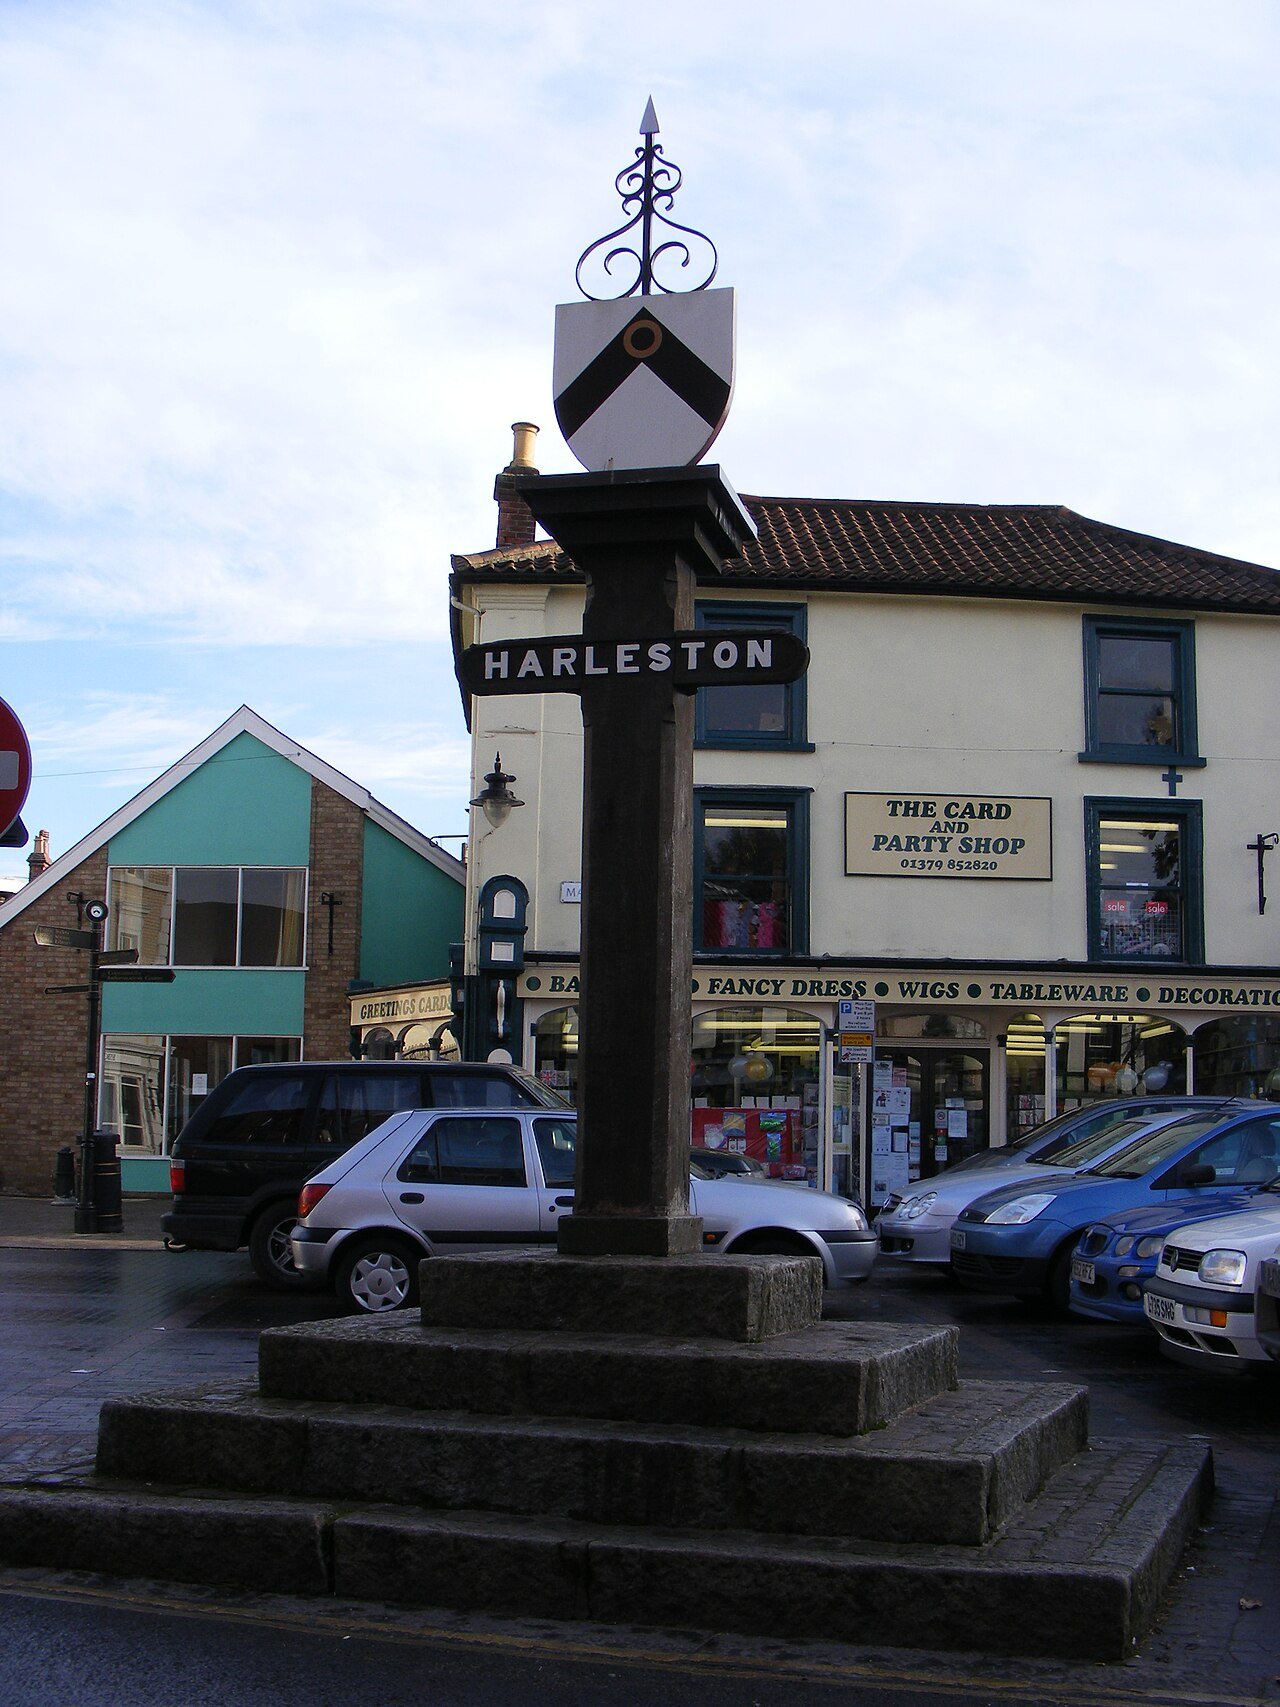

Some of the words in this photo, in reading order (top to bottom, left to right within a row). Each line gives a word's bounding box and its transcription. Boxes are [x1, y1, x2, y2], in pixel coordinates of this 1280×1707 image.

[484, 639, 772, 680] HARLESTON
[886, 800, 937, 817] THE
[943, 801, 1012, 820] CARD
[929, 821, 969, 834] AND
[871, 834, 953, 853] PARTY
[958, 836, 1026, 855] SHOP
[900, 858, 943, 871] 01379
[947, 859, 998, 871] 852820
[1107, 903, 1125, 912] sale
[1147, 904, 1165, 914] sale
[707, 978, 785, 996] FANCY
[791, 980, 867, 997] DRESS
[898, 981, 960, 999] WIGS
[990, 984, 1128, 1002] TABLEWARE
[360, 999, 416, 1020] GREETINGS
